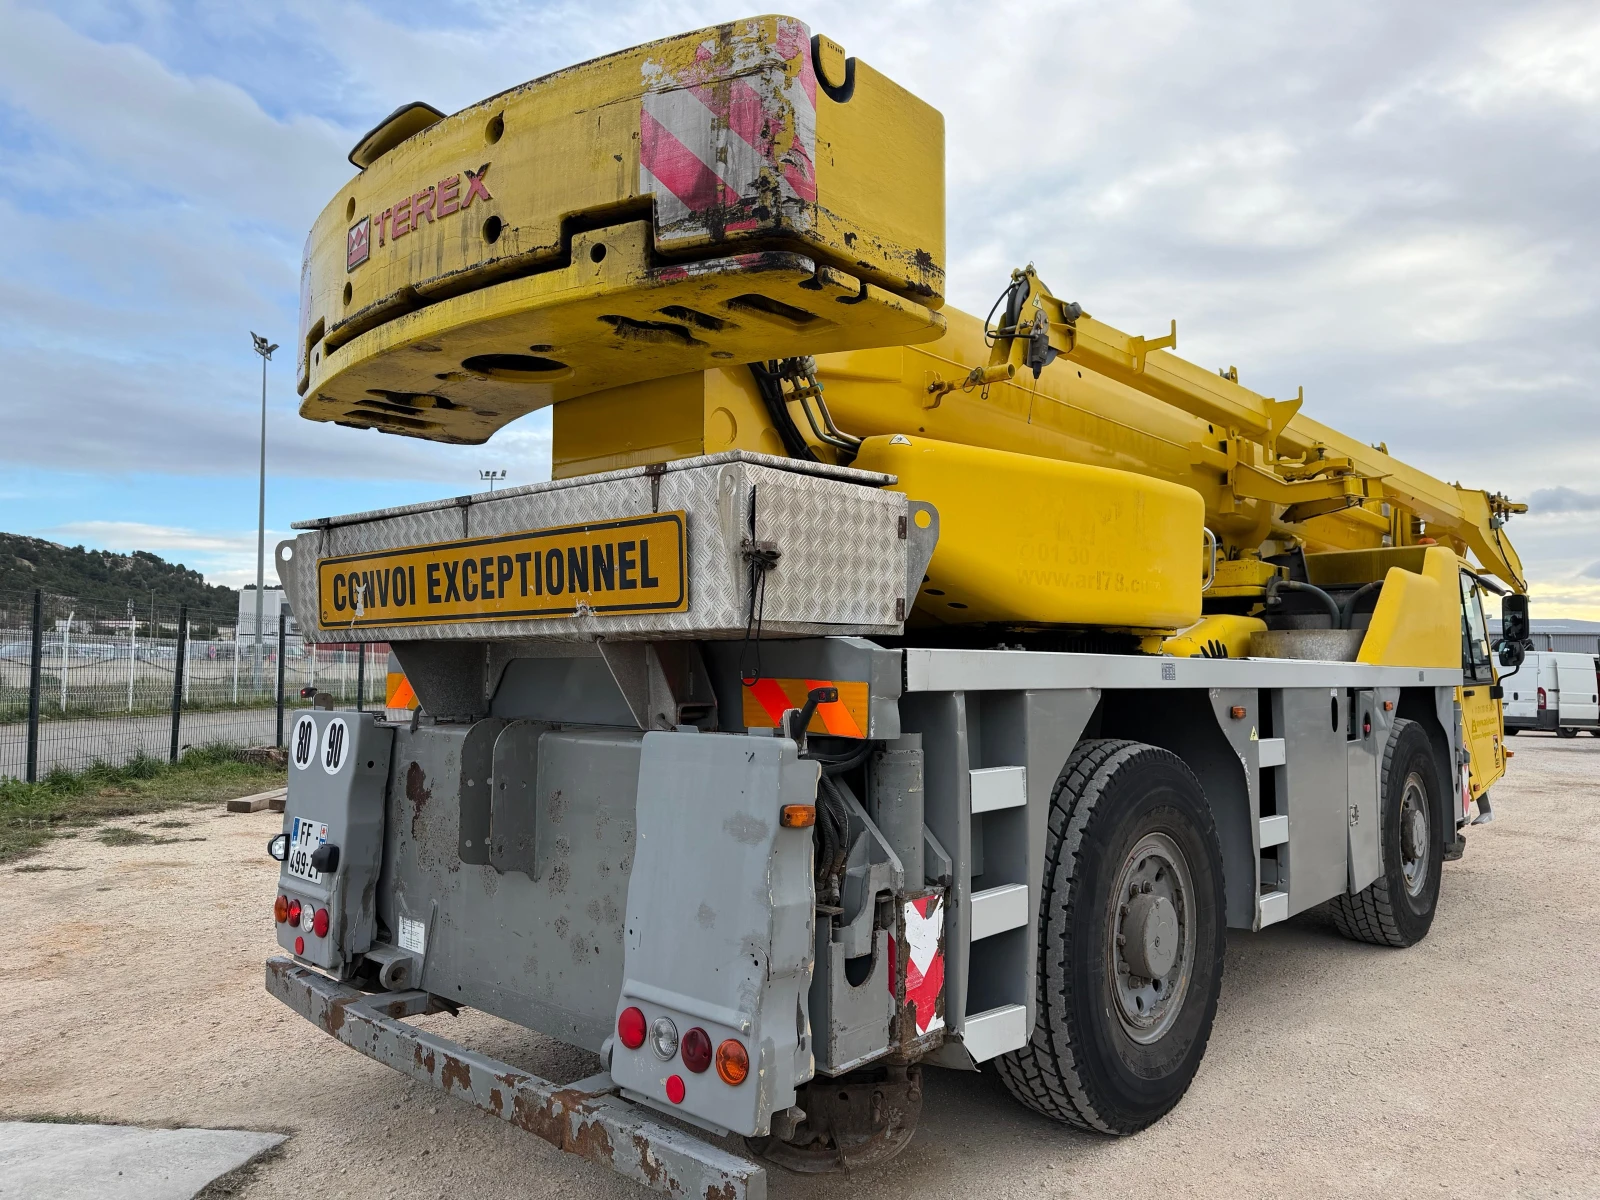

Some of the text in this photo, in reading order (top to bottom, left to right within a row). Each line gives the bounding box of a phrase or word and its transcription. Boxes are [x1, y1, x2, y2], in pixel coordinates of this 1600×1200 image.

[374, 162, 493, 247] TEREX
[333, 539, 659, 611] CONVOI EXCEPTIONNEL
[296, 720, 312, 765] 80
[326, 722, 344, 769] 90
